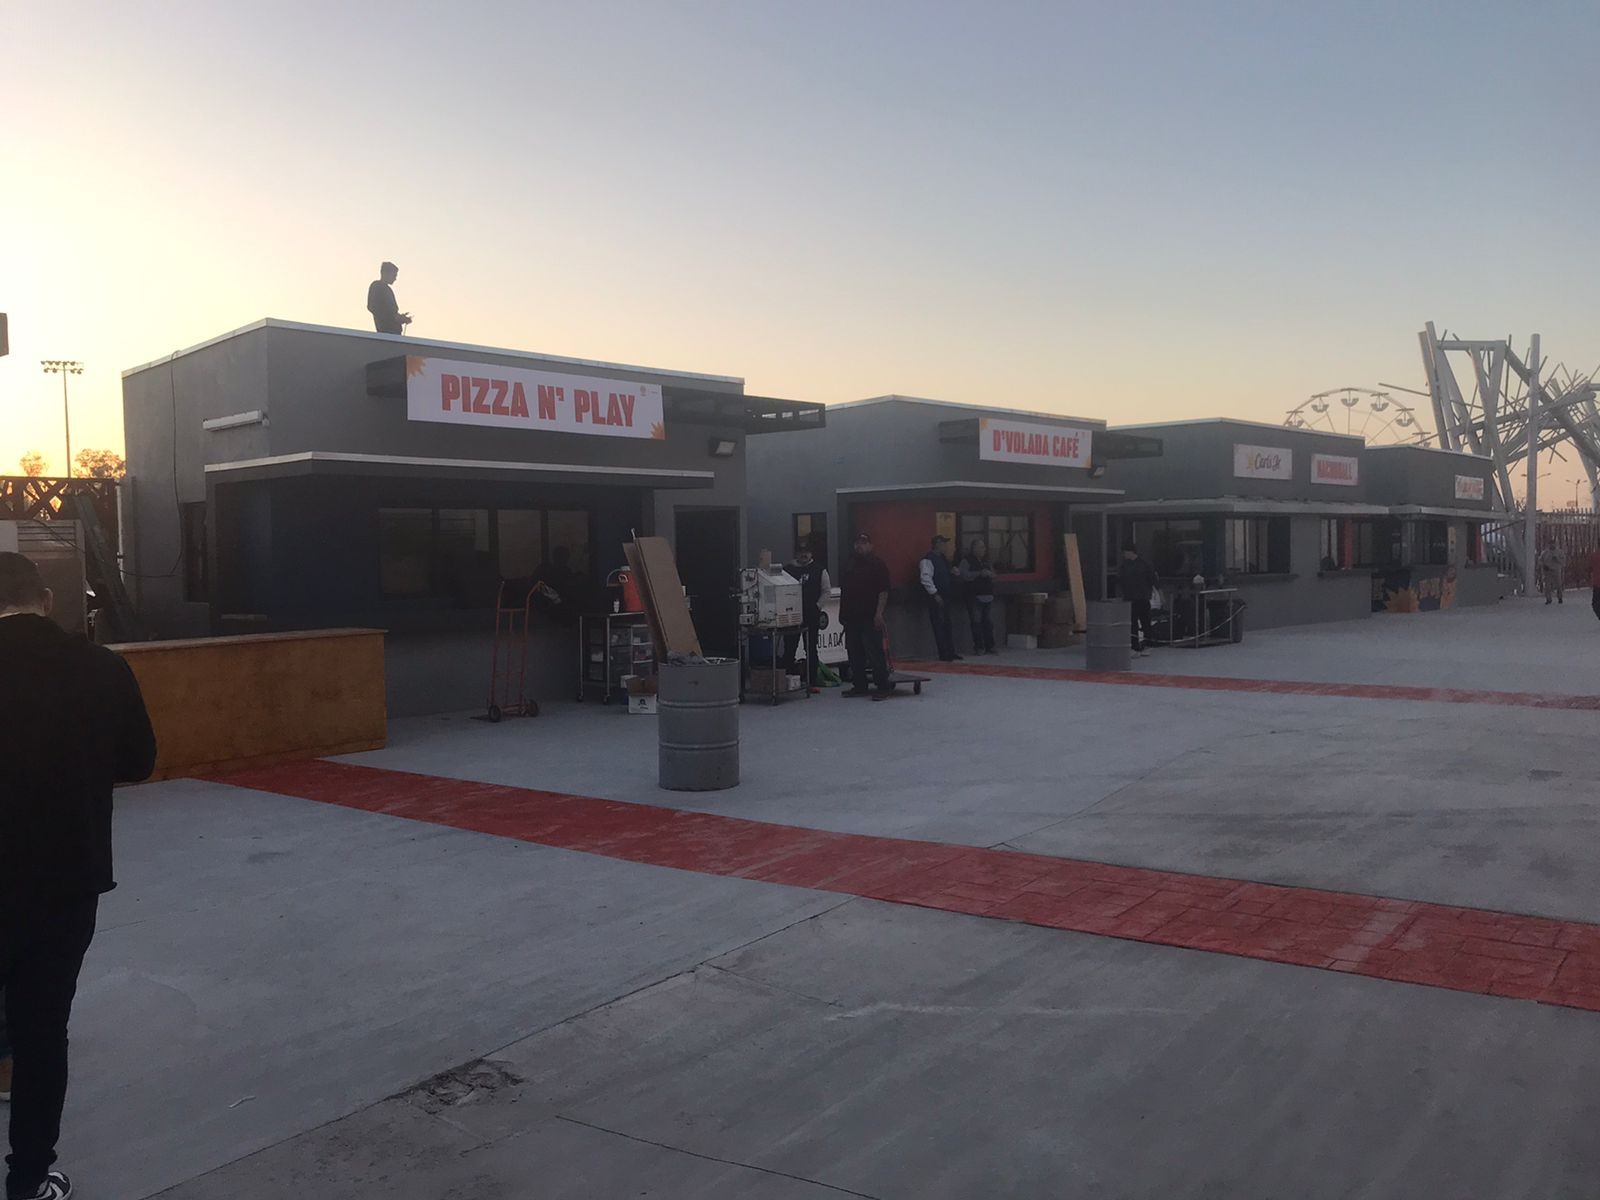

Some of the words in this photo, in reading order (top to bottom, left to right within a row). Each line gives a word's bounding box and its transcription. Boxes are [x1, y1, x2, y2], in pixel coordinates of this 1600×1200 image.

[441, 373, 530, 418] PIZZA
[574, 389, 635, 427] PLAY
[1053, 432, 1079, 458] CAFÉ
